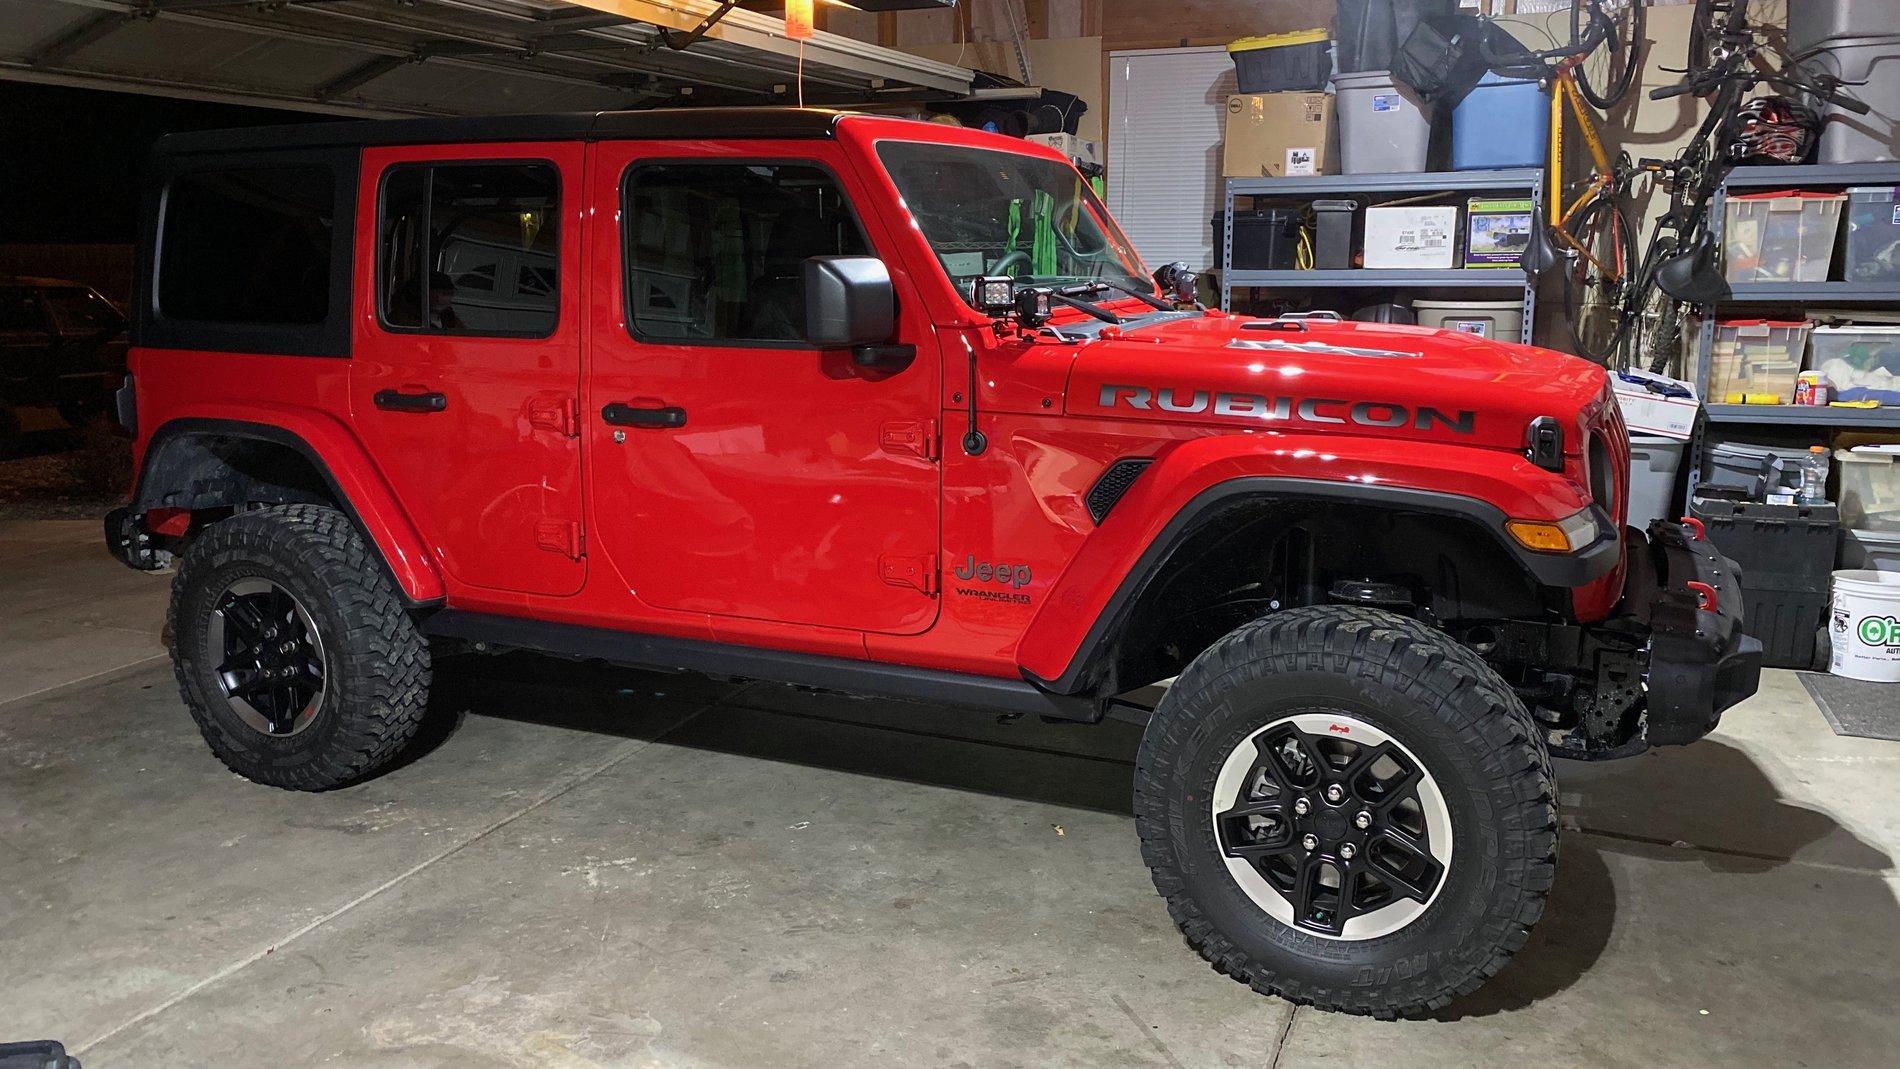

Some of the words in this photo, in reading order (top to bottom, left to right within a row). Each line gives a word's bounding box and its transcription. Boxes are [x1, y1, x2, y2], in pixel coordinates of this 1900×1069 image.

[1100, 384, 1475, 433] RUBICON
[955, 554, 1032, 590] Jeep
[956, 587, 1031, 602] WRANGLER
